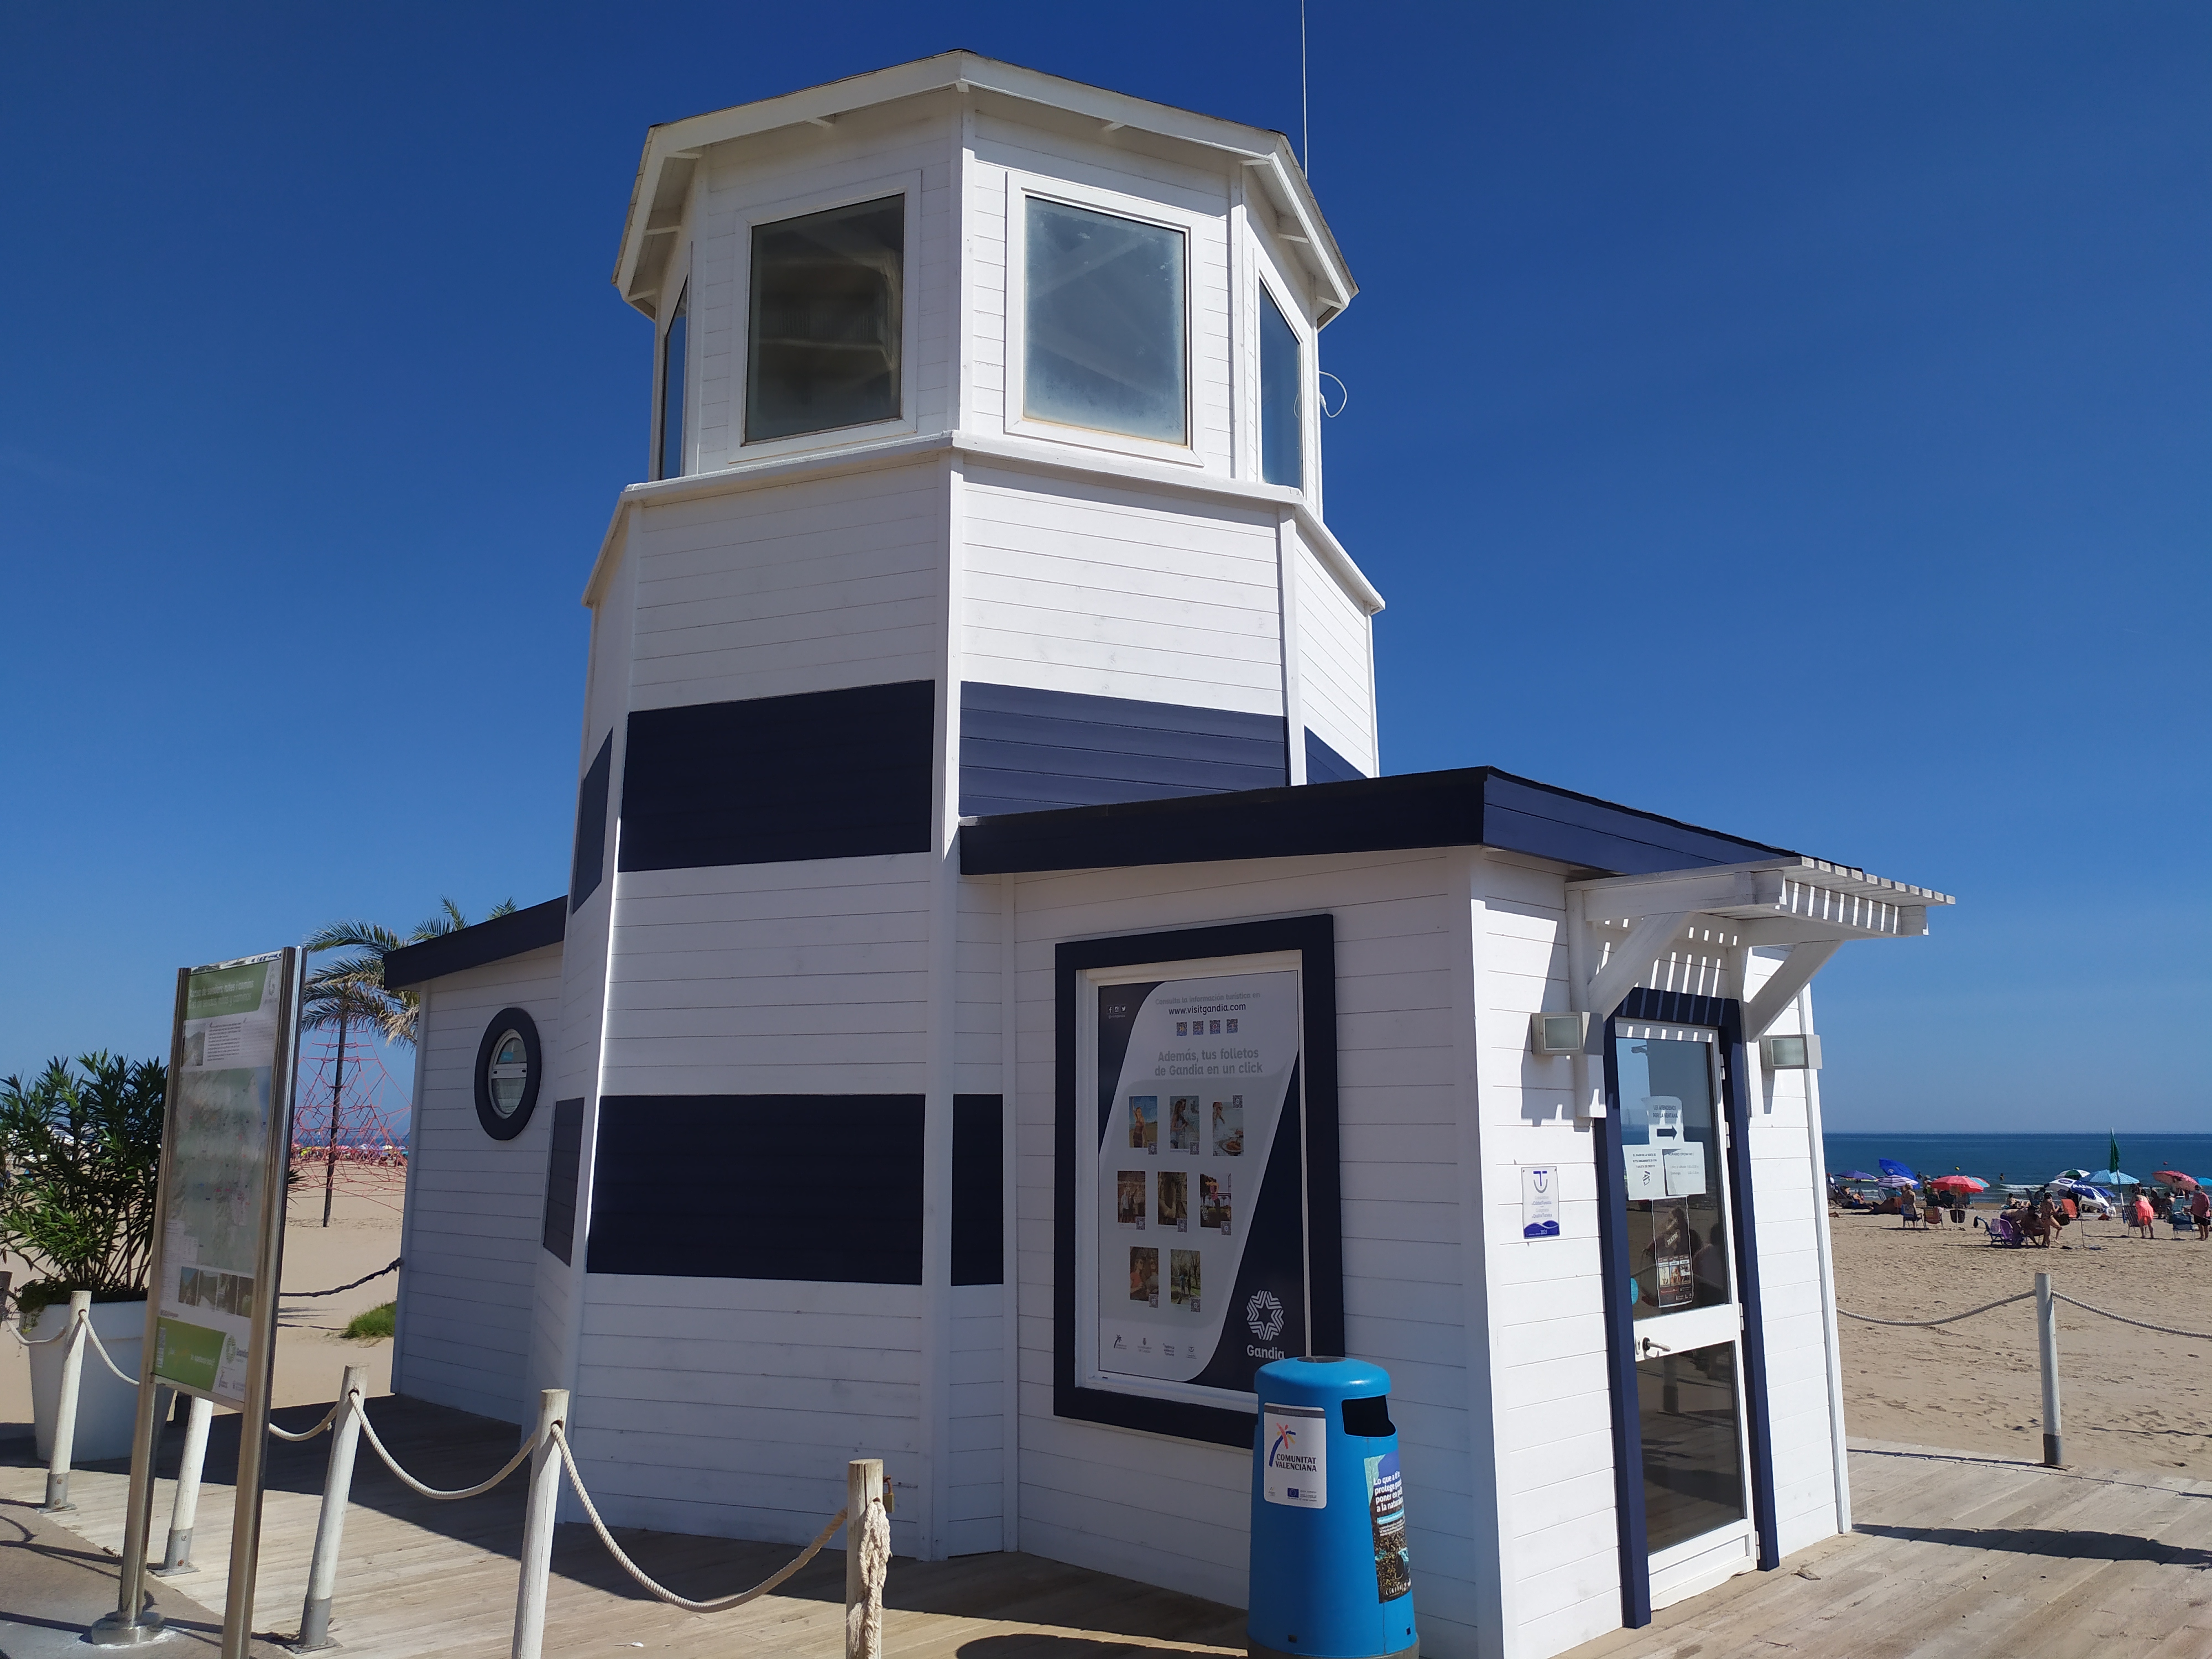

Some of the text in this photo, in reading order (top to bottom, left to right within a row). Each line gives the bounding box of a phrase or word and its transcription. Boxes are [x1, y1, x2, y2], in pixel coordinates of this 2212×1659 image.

[1155, 997, 1180, 1005] Consulta
[1189, 993, 1224, 1003] información
[1168, 1003, 1246, 1015] www.visitgandia.com
[1157, 1047, 1259, 1063] Además, tus folletos
[1155, 1061, 1263, 1076] de Gandia en un click
[1246, 1344, 1285, 1360] Gandia
[1276, 1453, 1317, 1464] COMUNITAT
[1275, 1460, 1317, 1472] VALENCIANA
[1374, 1477, 1381, 1485] Lo
[1383, 1476, 1392, 1485] que
[1374, 1483, 1395, 1496] protege
[1375, 1493, 1392, 1505] poner
[1381, 1503, 1387, 1511] la
